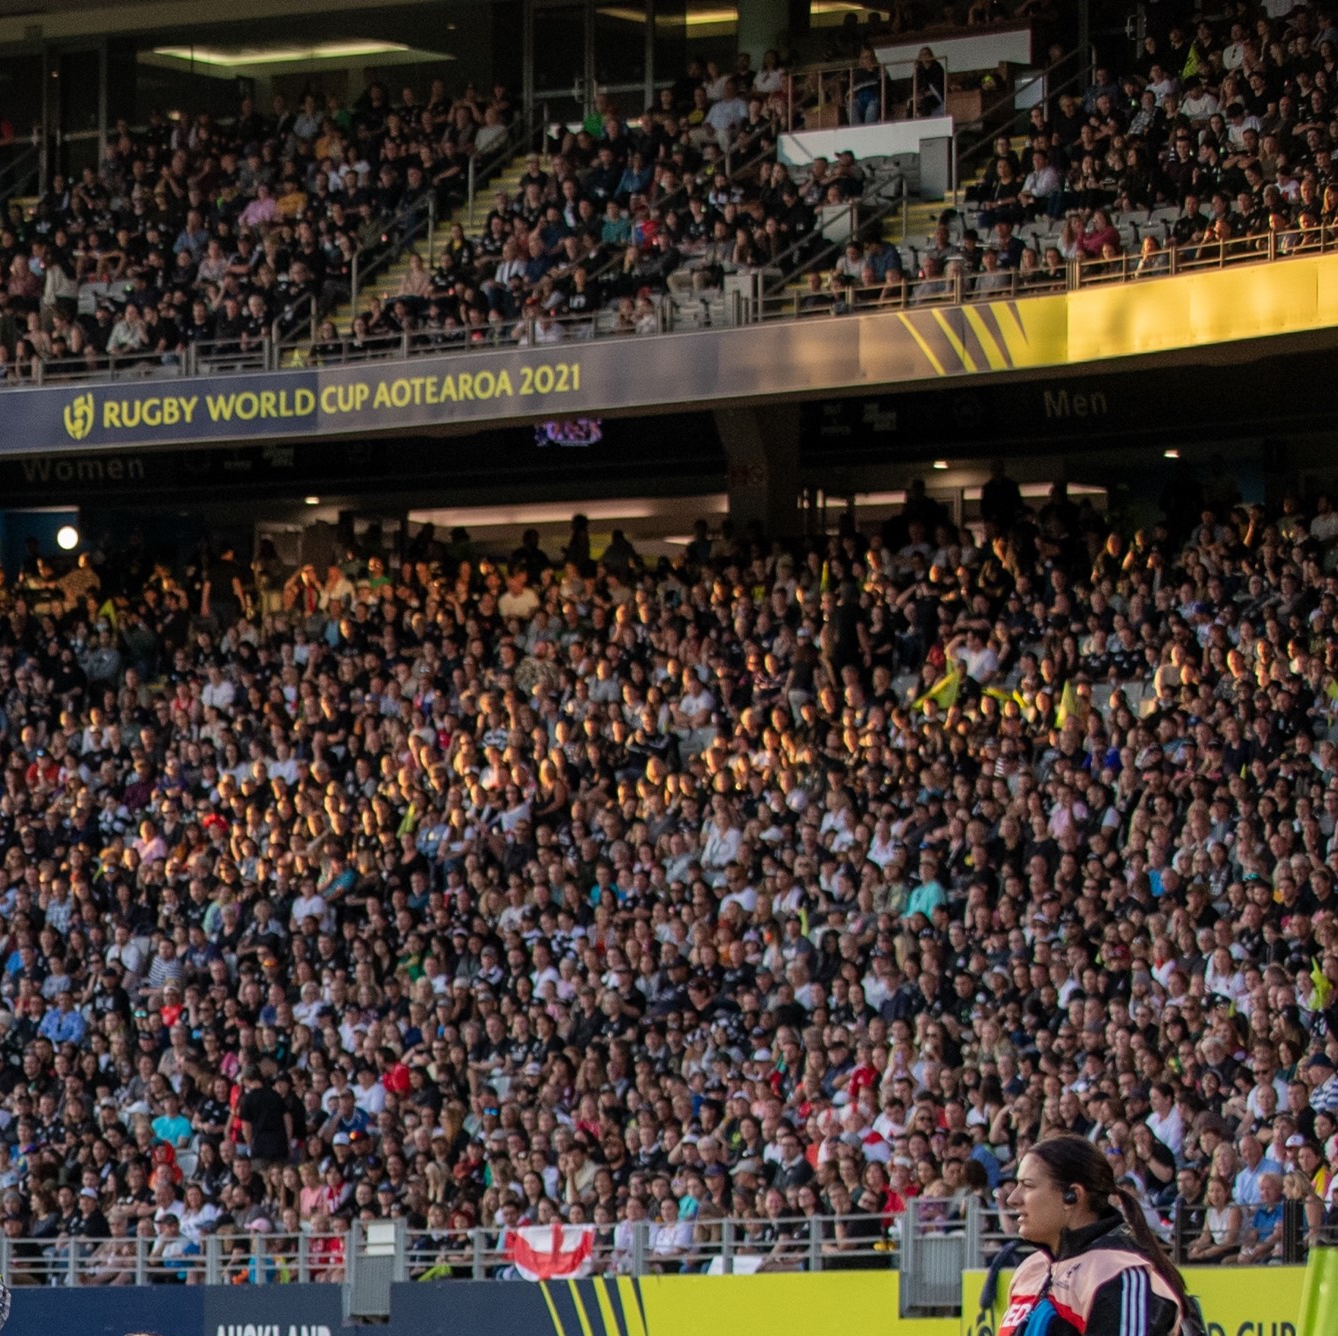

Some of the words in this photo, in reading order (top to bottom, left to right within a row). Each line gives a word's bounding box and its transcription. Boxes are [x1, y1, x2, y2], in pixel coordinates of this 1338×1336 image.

[103, 395, 198, 428] RUGBY
[205, 388, 316, 422] WORLD
[320, 383, 369, 414] CUP
[373, 370, 513, 409] AOTEAROA
[519, 363, 581, 395] 2021
[1043, 389, 1109, 418] Men
[24, 457, 145, 482] Women
